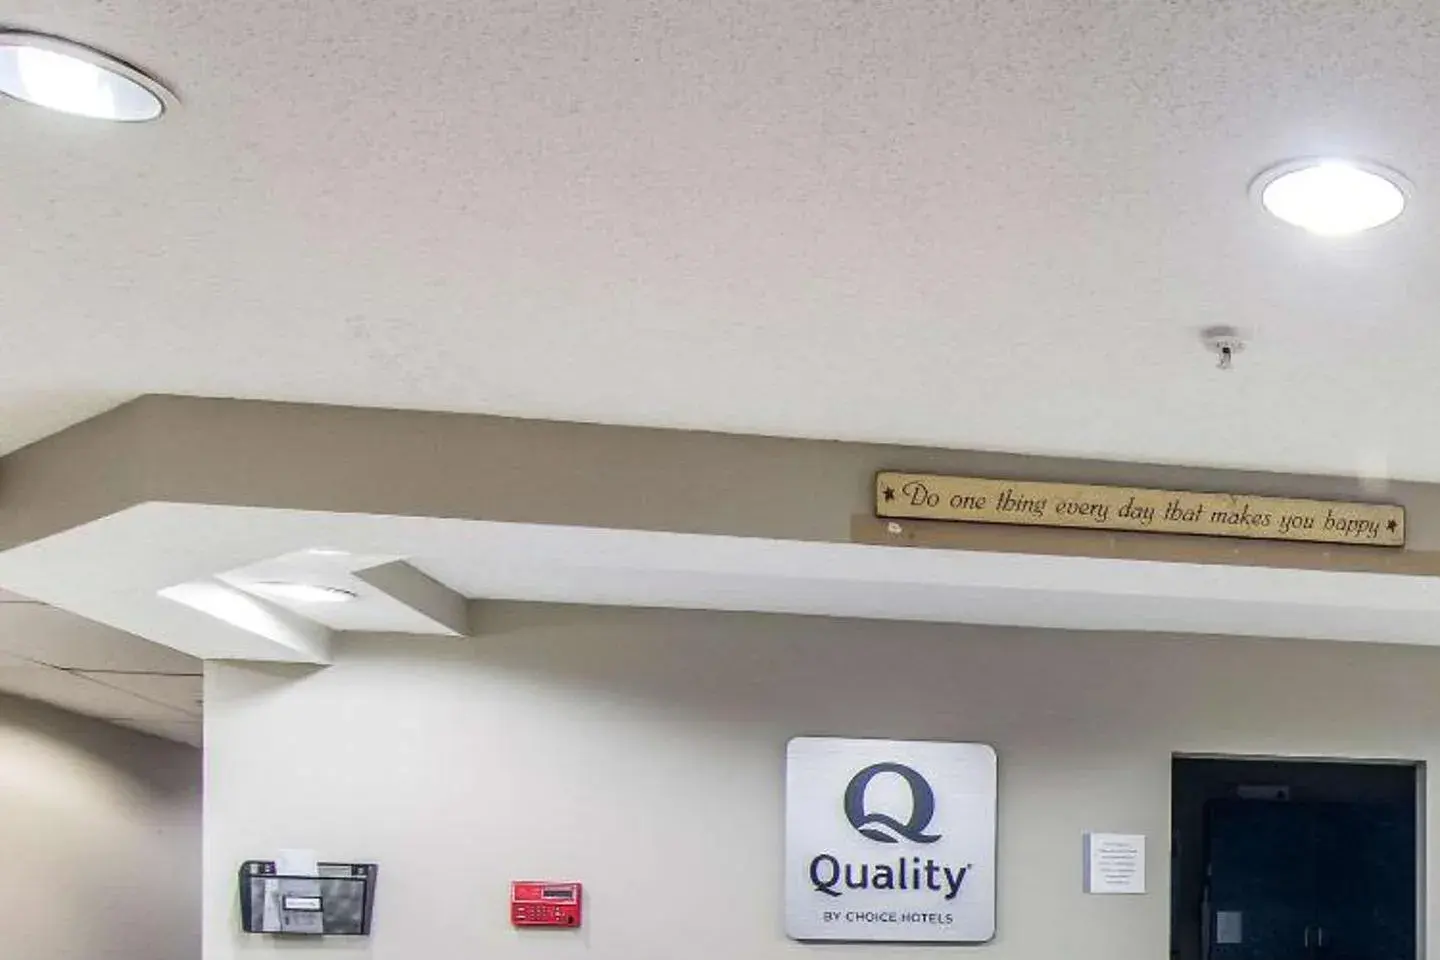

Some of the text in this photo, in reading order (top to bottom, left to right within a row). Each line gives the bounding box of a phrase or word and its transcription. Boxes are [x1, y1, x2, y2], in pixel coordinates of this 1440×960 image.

[902, 481, 1380, 538] Do one thing every day that makes you happy
[843, 762, 943, 844] Q
[809, 853, 968, 900] Quality
[823, 911, 953, 925] BY CHOICE HOTELS
